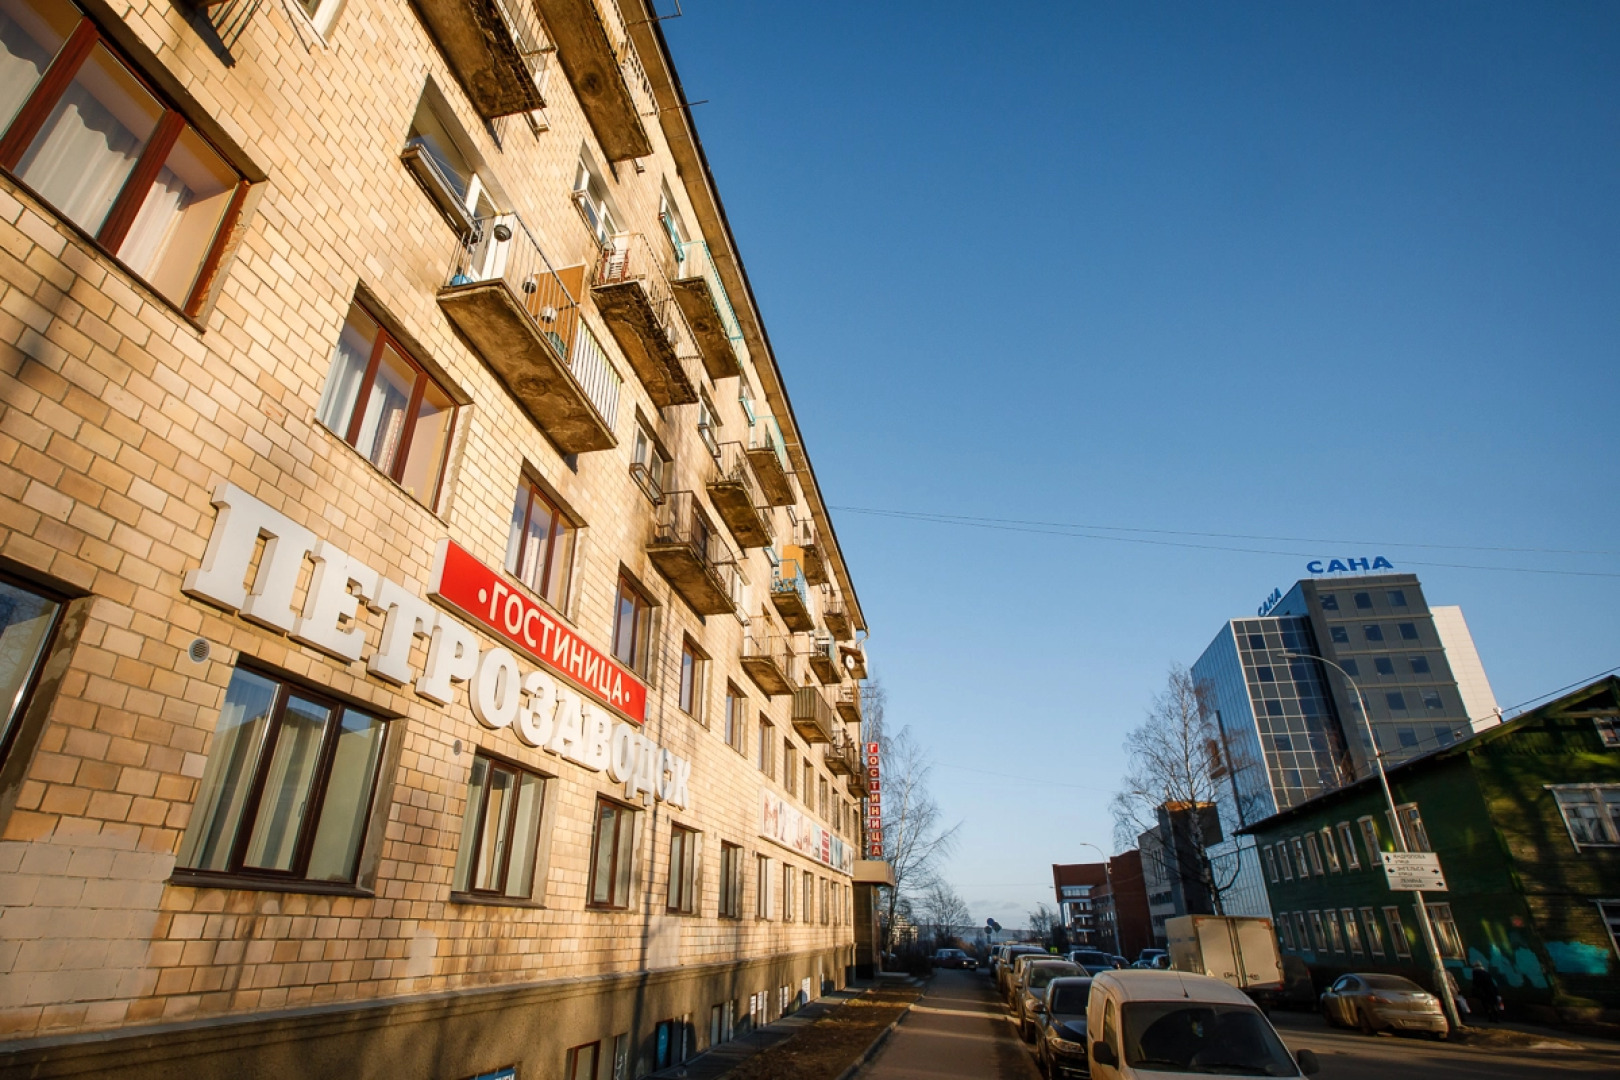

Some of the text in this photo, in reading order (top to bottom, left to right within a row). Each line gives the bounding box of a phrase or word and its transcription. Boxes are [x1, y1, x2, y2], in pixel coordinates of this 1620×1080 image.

[1257, 587, 1282, 616] САНА
[1306, 556, 1394, 574] САНА
[181, 482, 691, 810] ПЕТРОЗАВОДСК
[489, 581, 623, 706] ГОСТИНИЦА
[869, 743, 882, 856] ГОСТИНИЦА
